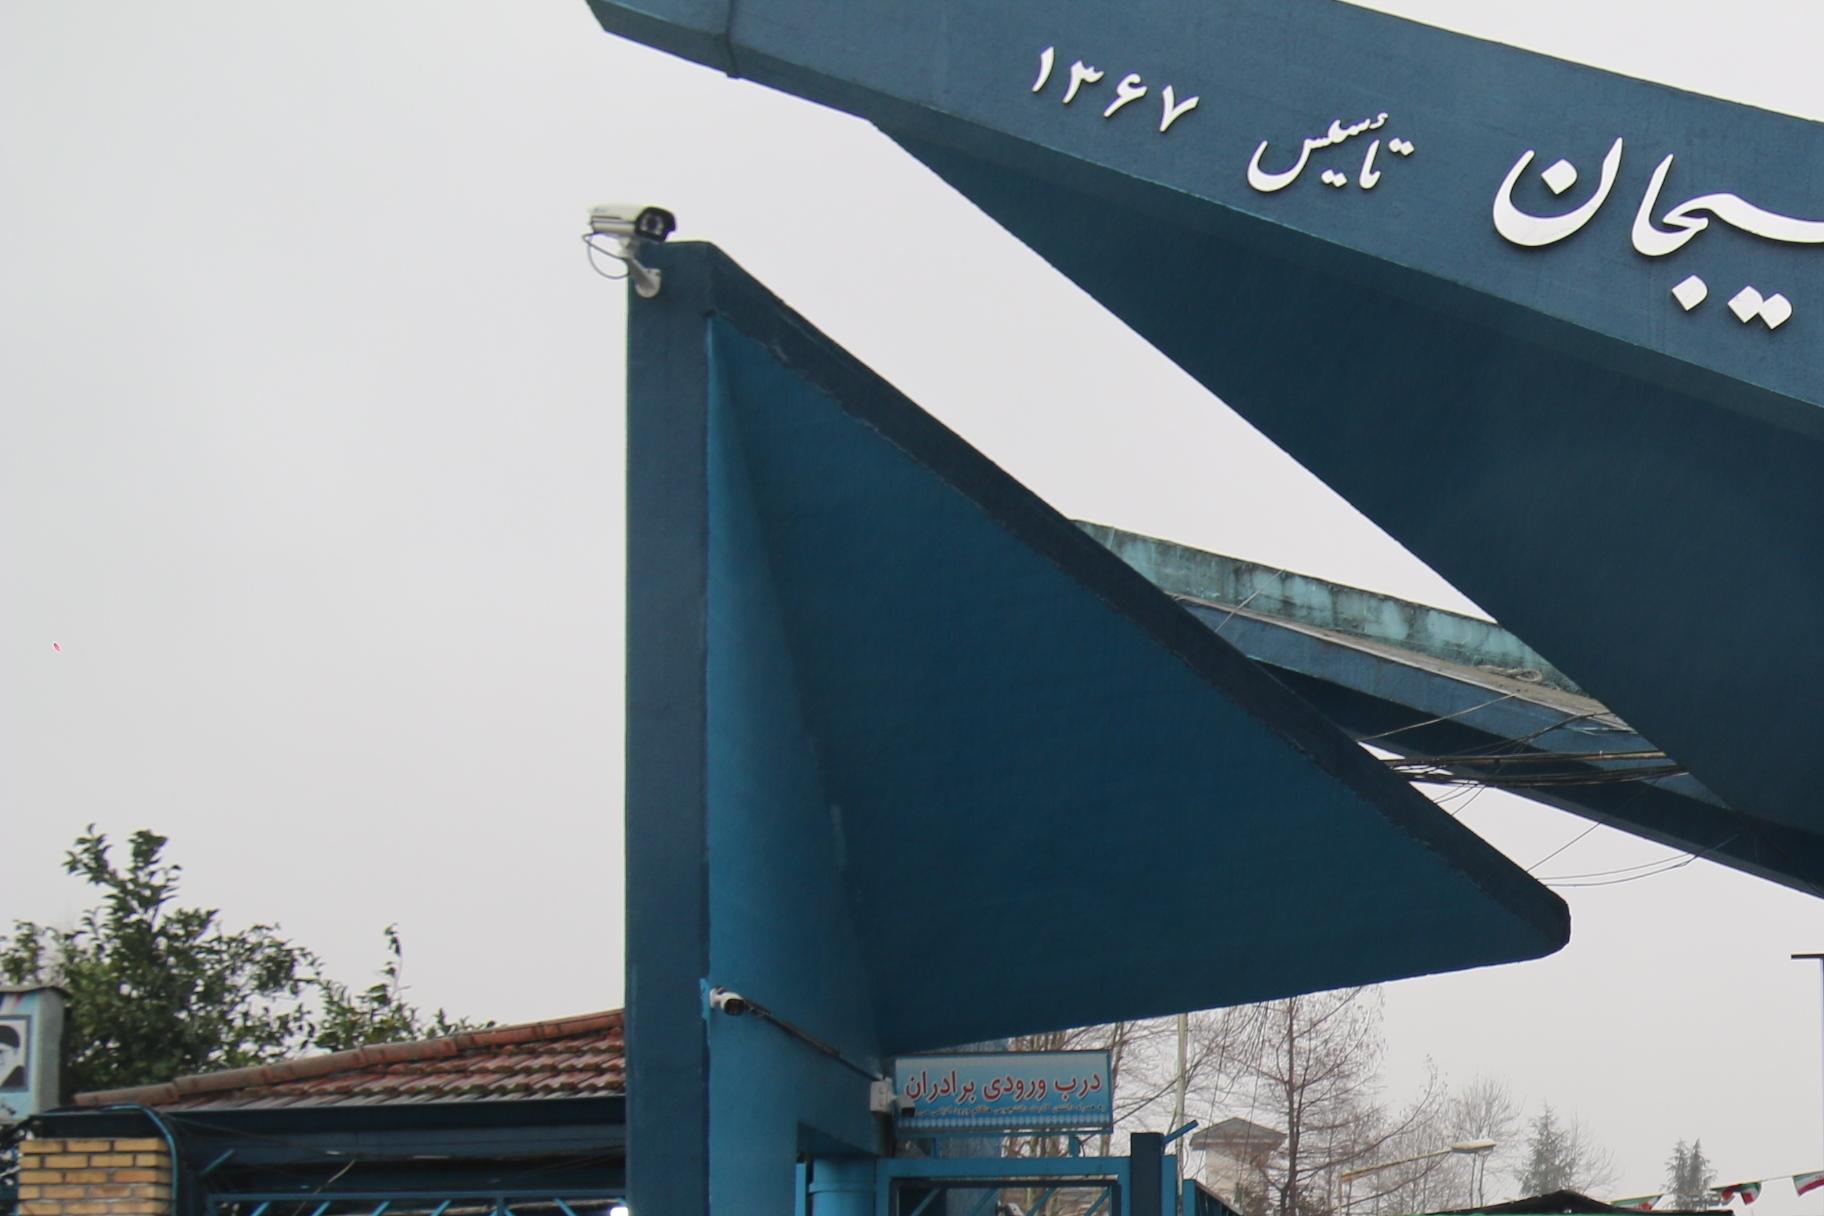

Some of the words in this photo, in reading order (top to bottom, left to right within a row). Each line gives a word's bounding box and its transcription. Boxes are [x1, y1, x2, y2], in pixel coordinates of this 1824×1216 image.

[1031, 46, 1199, 132] ۱۳۶۷
[905, 1070, 976, 1103] برادران
[983, 1074, 1047, 1100] ورودی
[1055, 1072, 1102, 1099] درب
